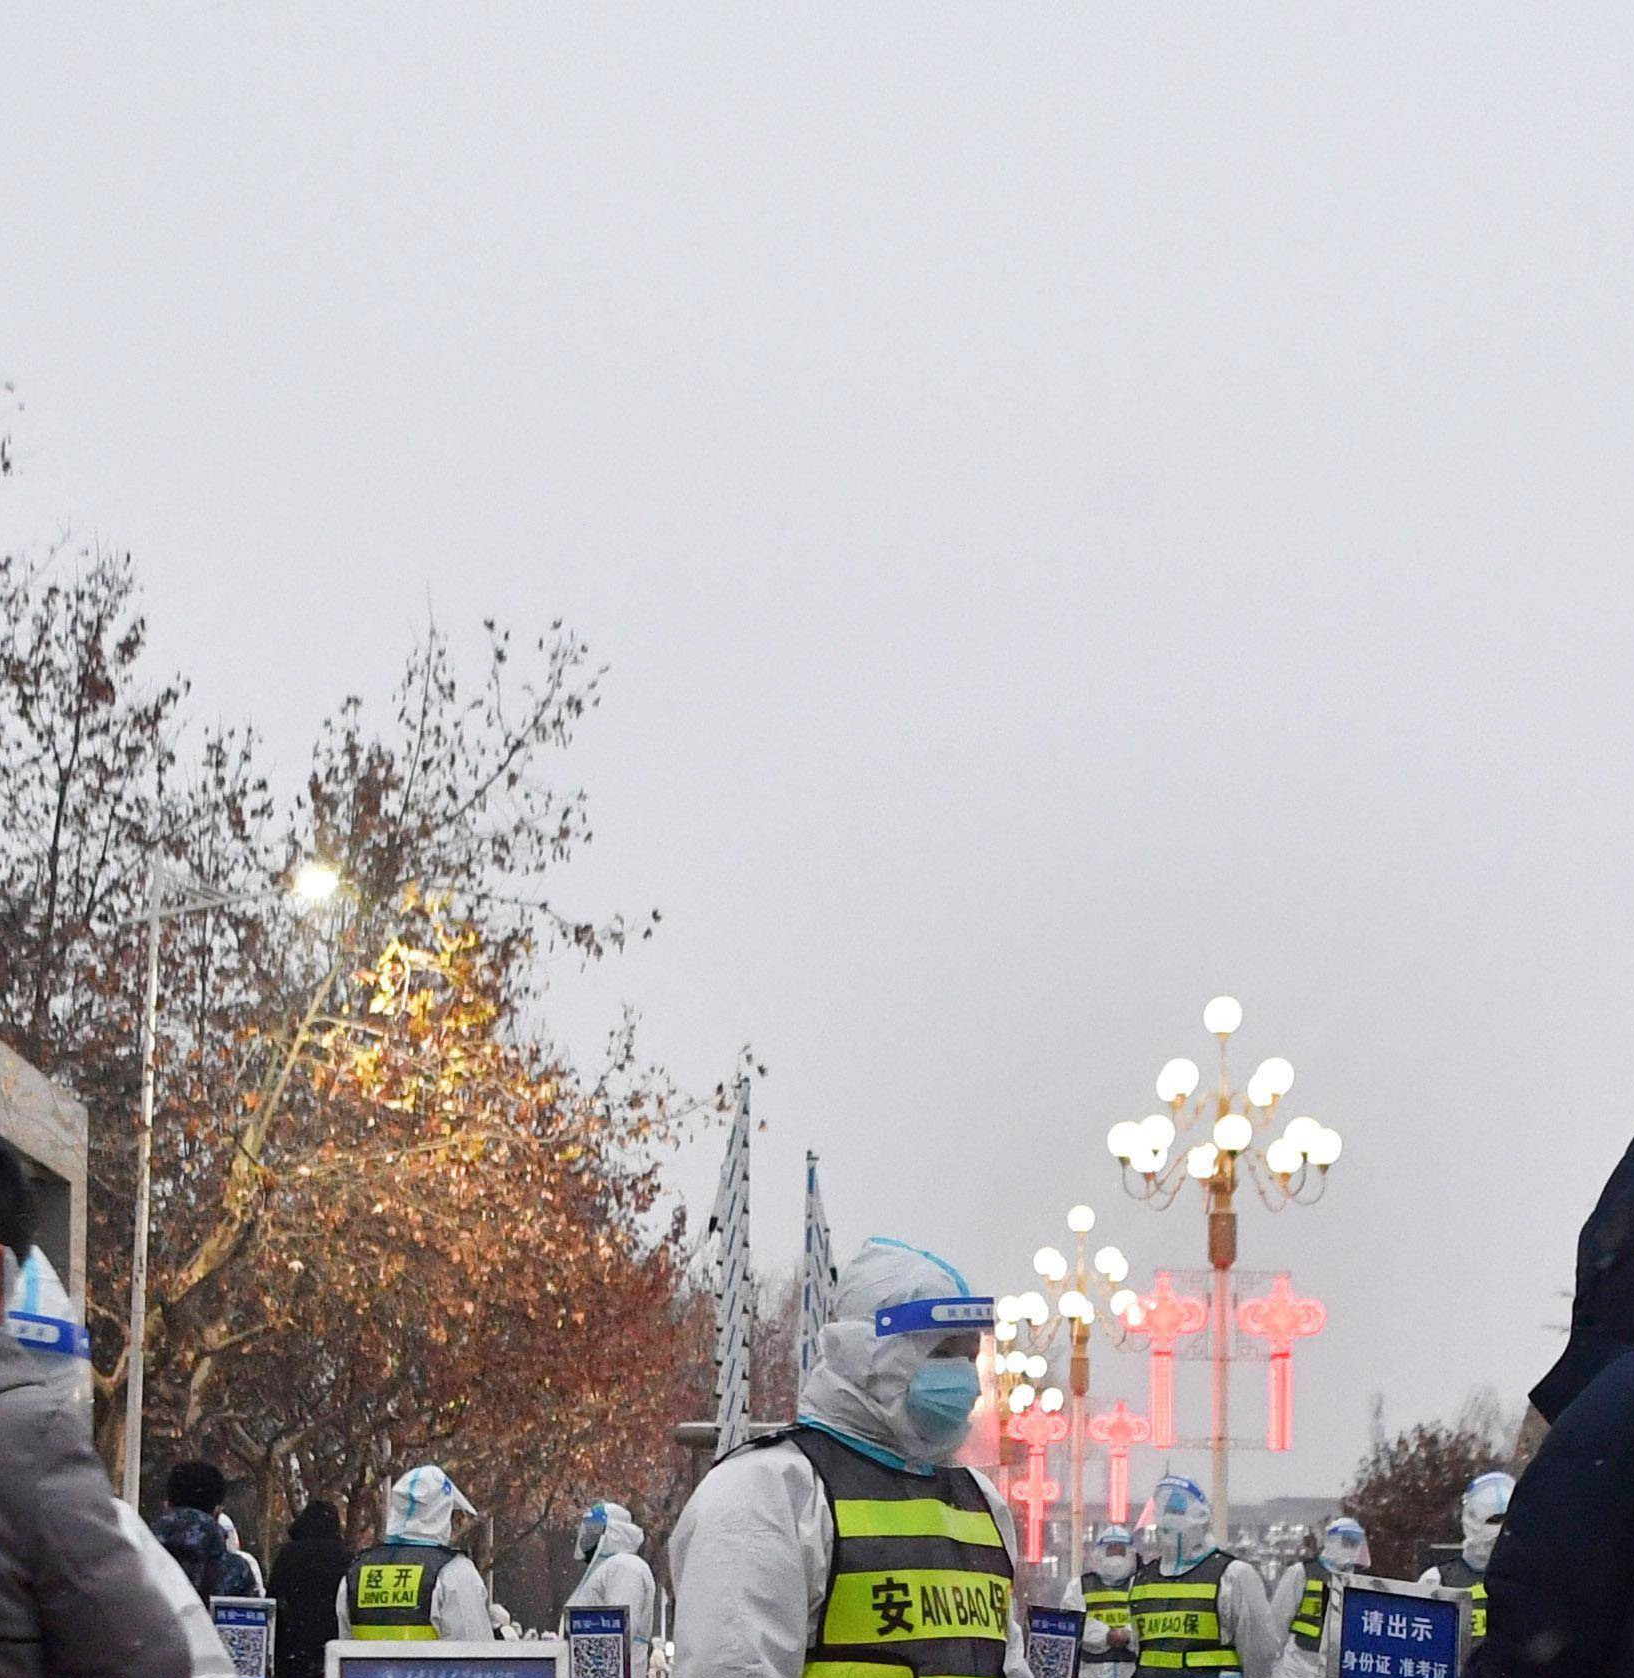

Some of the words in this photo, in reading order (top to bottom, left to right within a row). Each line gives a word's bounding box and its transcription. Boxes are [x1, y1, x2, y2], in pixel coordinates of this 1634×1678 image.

[365, 1568, 413, 1588] 经开
[360, 1590, 389, 1606] JING
[392, 1590, 415, 1604] KAI
[871, 1576, 915, 1637] 安
[920, 1585, 953, 1627] AN
[951, 1585, 990, 1628] BAO
[1183, 1613, 1200, 1635] 保
[1362, 1610, 1433, 1642] 请出示
[1342, 1650, 1392, 1676] 身份证
